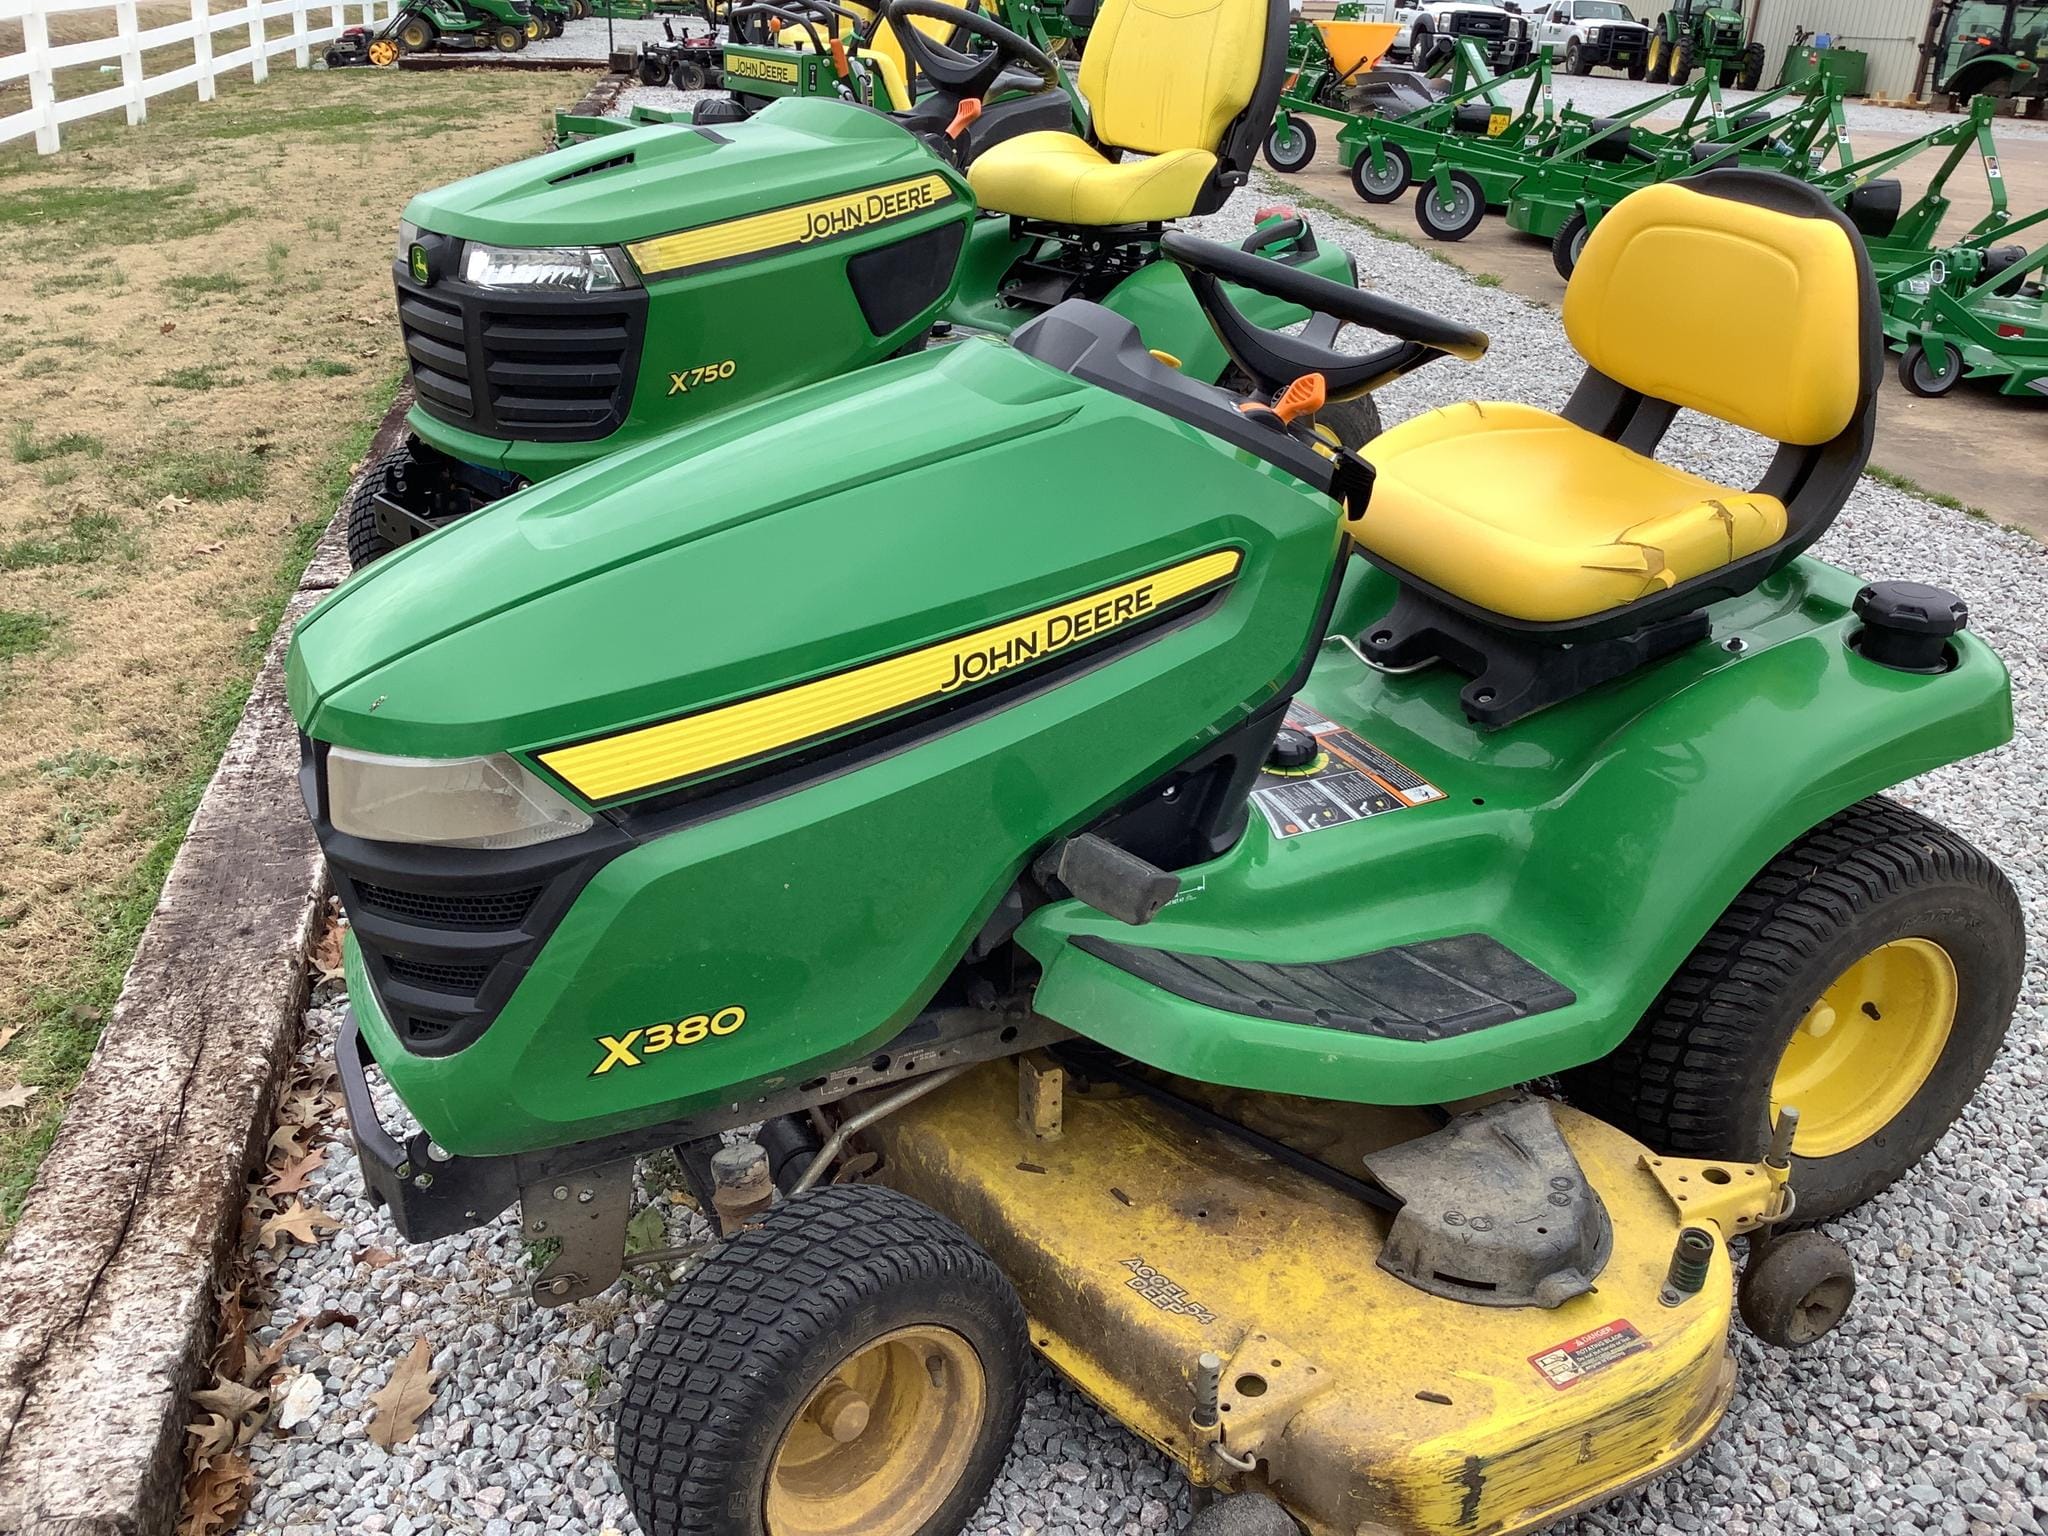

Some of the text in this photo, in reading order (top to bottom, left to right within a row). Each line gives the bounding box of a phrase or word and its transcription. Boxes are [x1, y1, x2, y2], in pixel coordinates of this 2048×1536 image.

[734, 57, 789, 81] JOHN DEERE
[800, 183, 934, 241] JOHN DEERE
[666, 359, 736, 396] X750
[941, 583, 1156, 691] JOHN DEERE
[589, 1005, 747, 1076] X380
[1119, 1258, 1218, 1325] ACCEL 54
[1124, 1277, 1186, 1314] DEEP
[1583, 1326, 1614, 1343] DANGER
